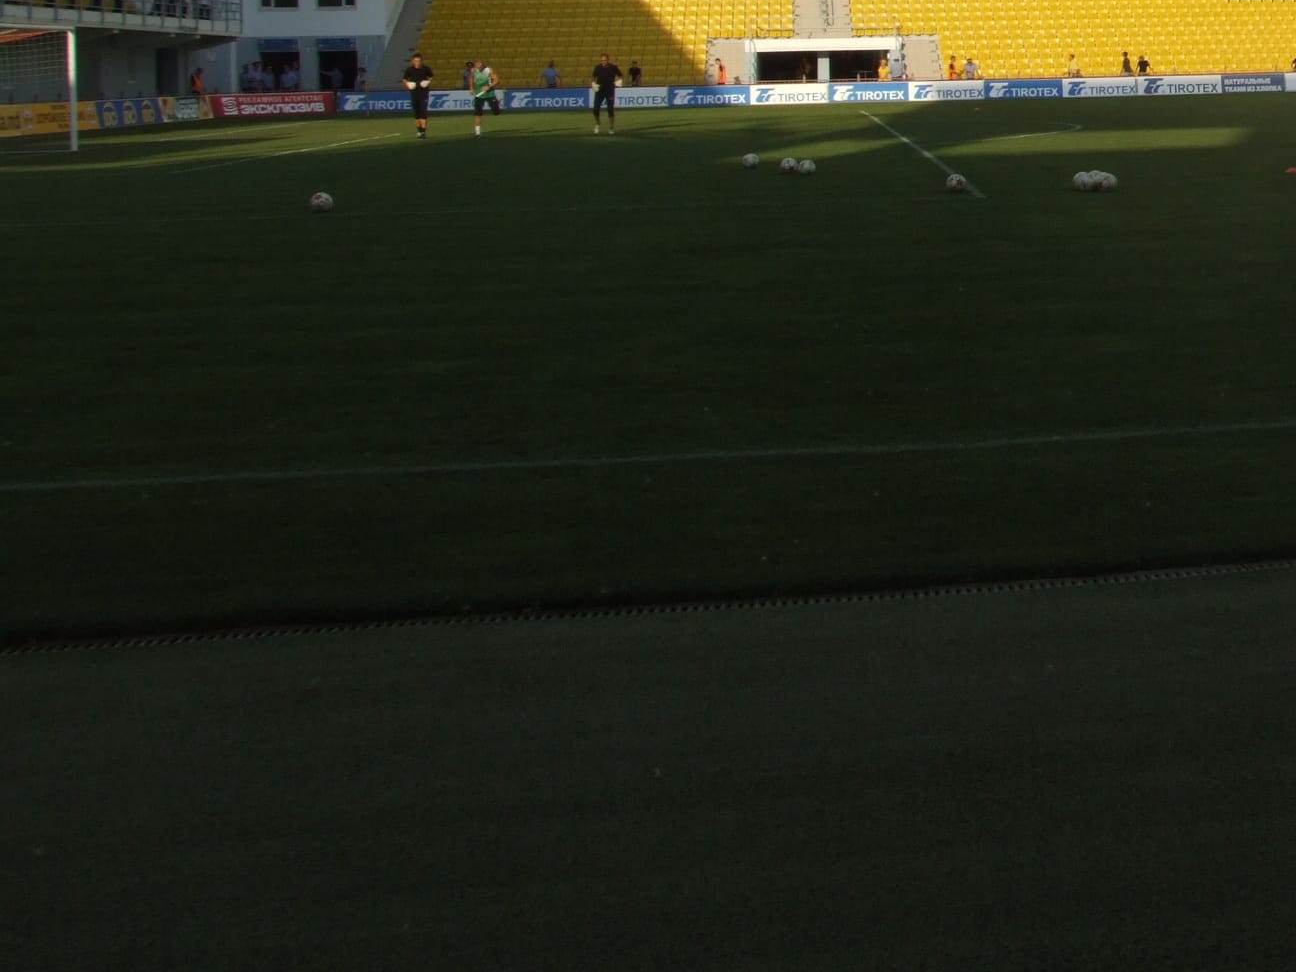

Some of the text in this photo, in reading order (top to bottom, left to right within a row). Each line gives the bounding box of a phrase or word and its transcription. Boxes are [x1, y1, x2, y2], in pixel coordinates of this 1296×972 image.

[1011, 87, 1059, 97] TIROTEX
[1088, 85, 1136, 95] TIROTEX
[1167, 83, 1218, 93] TIROTEX
[778, 92, 828, 102] TIROTEX
[855, 90, 905, 101] TIROTEX
[936, 88, 984, 99] TIROTEX
[534, 97, 585, 107] TIROTEX
[617, 96, 668, 106] TIROTEX
[695, 94, 746, 104] TIROTEX
[240, 103, 325, 115] ЭКСКЛЮЗИВ
[368, 99, 412, 110] TIROTE
